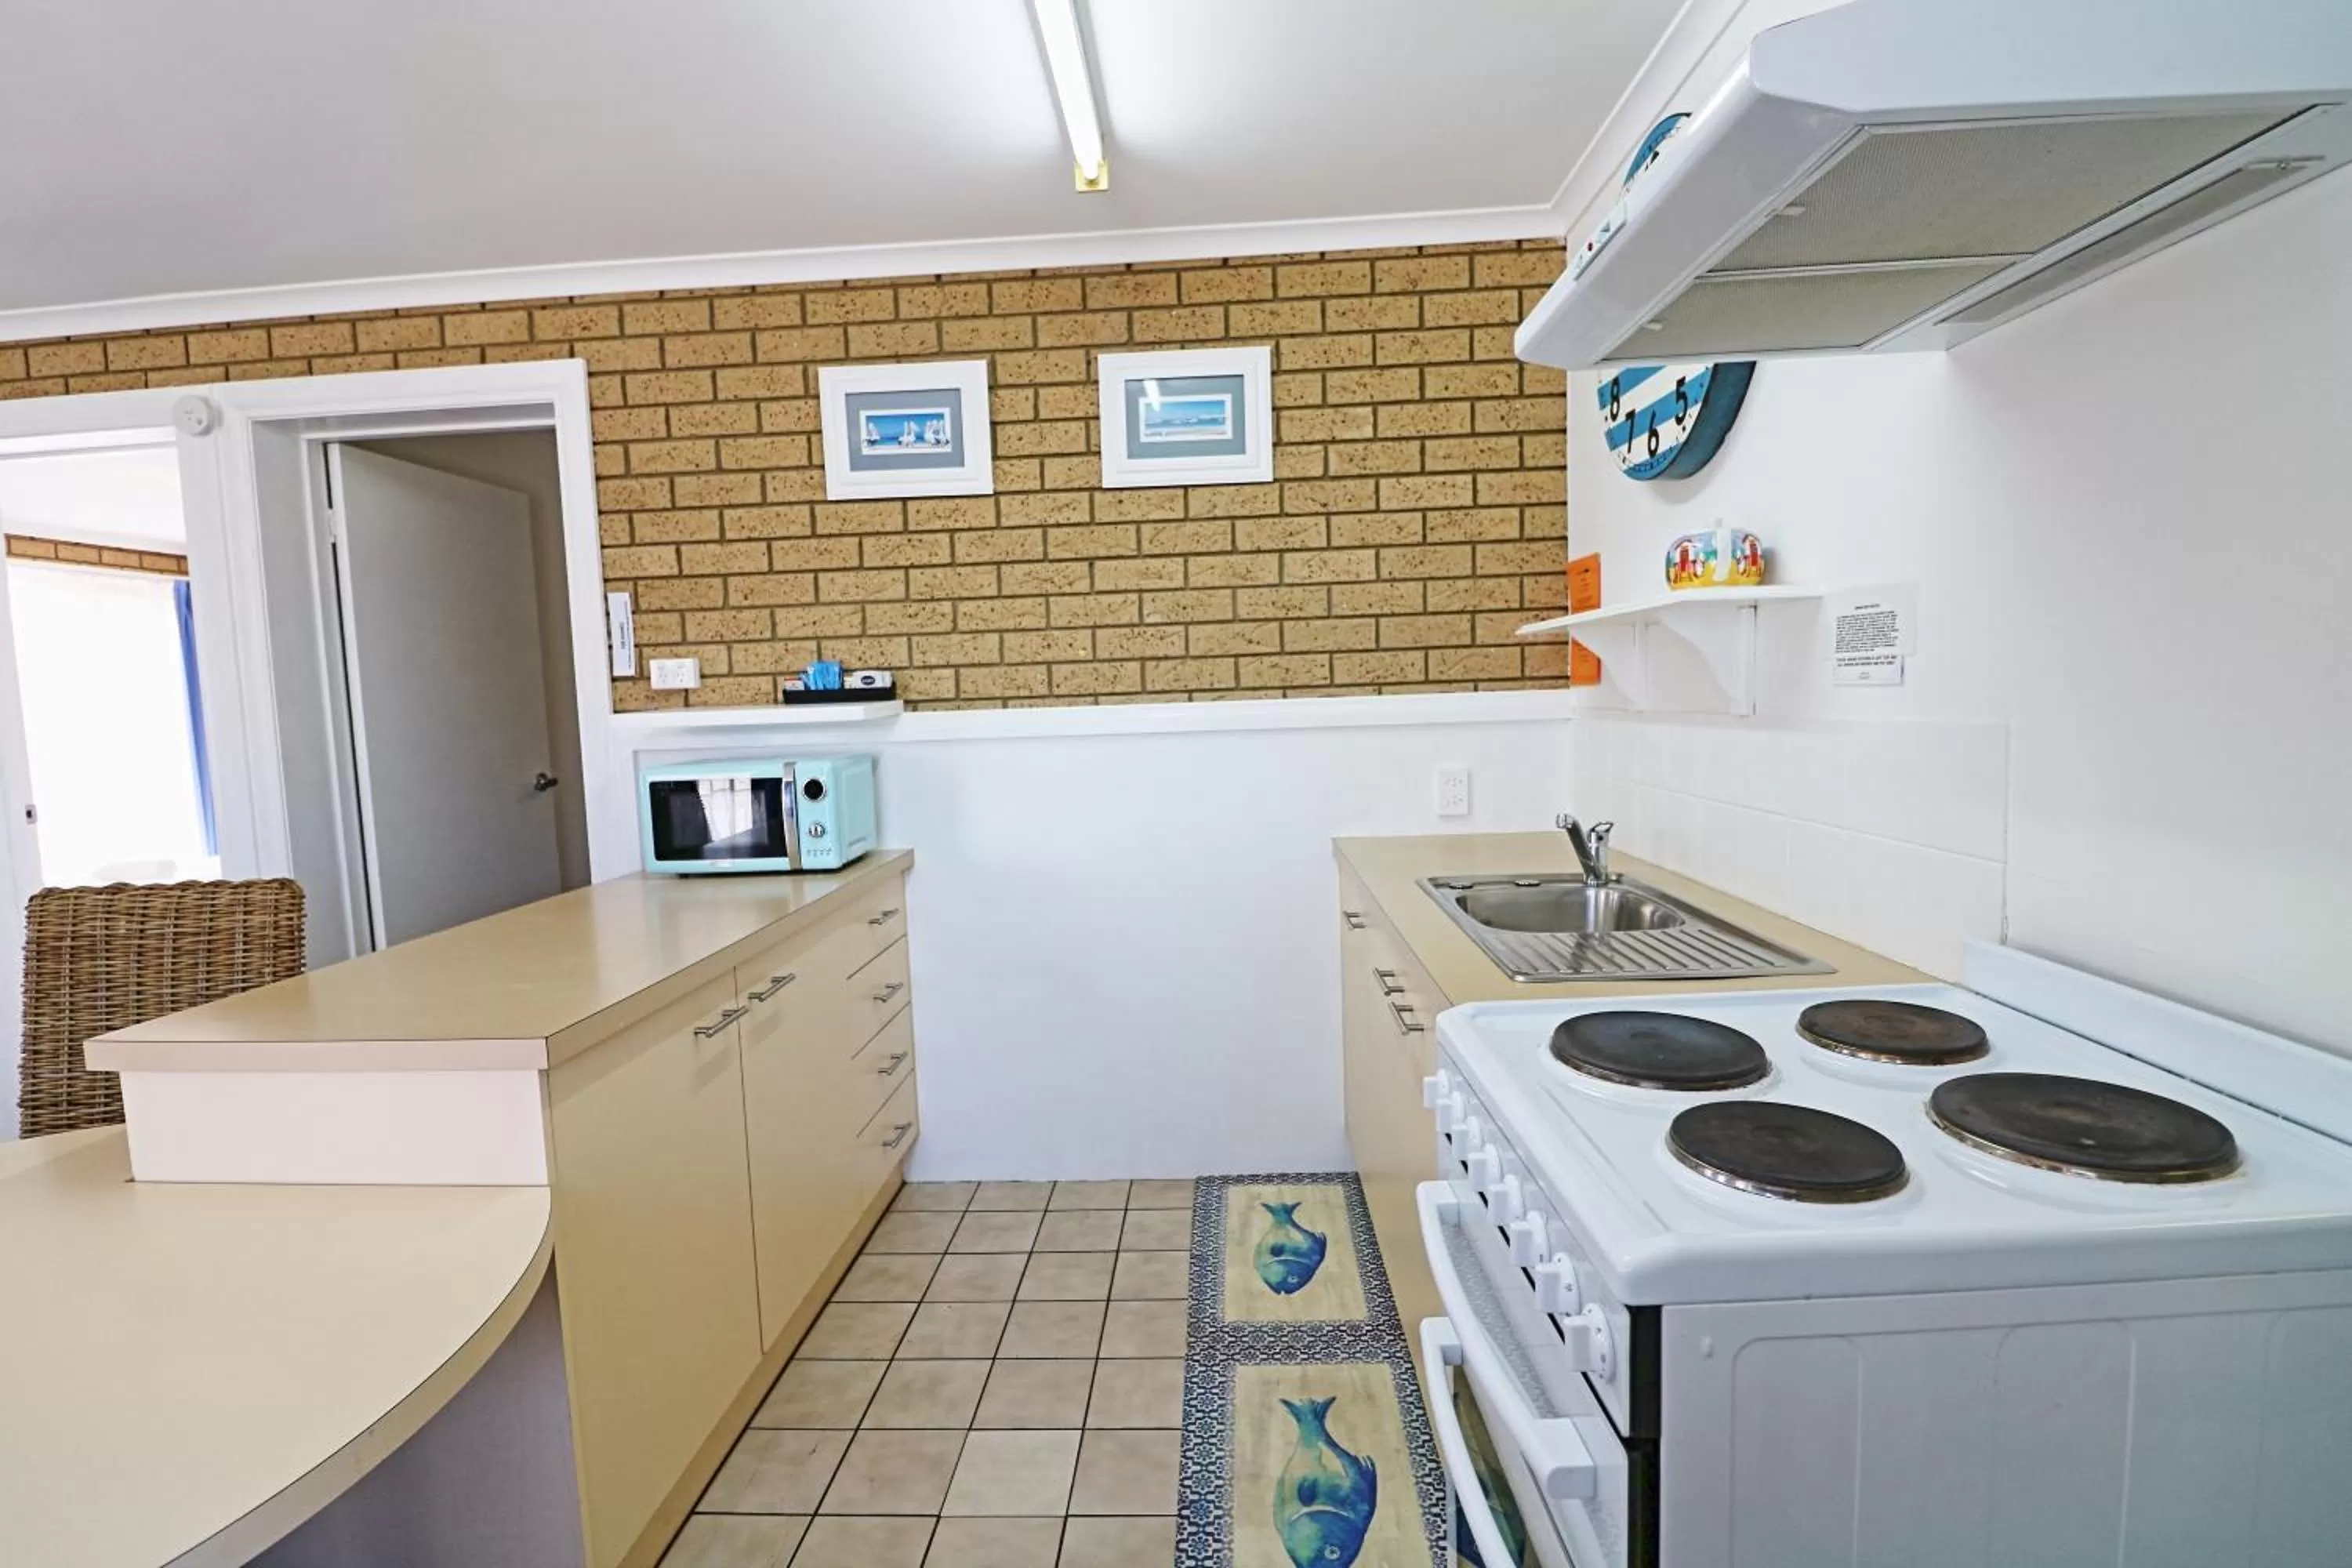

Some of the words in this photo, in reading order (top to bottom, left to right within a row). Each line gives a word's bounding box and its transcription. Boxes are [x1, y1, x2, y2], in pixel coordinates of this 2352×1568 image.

[1610, 376, 1621, 422] 8
[1675, 376, 1687, 426] 5
[1625, 408, 1636, 454] 7
[1648, 409, 1660, 459] 6
